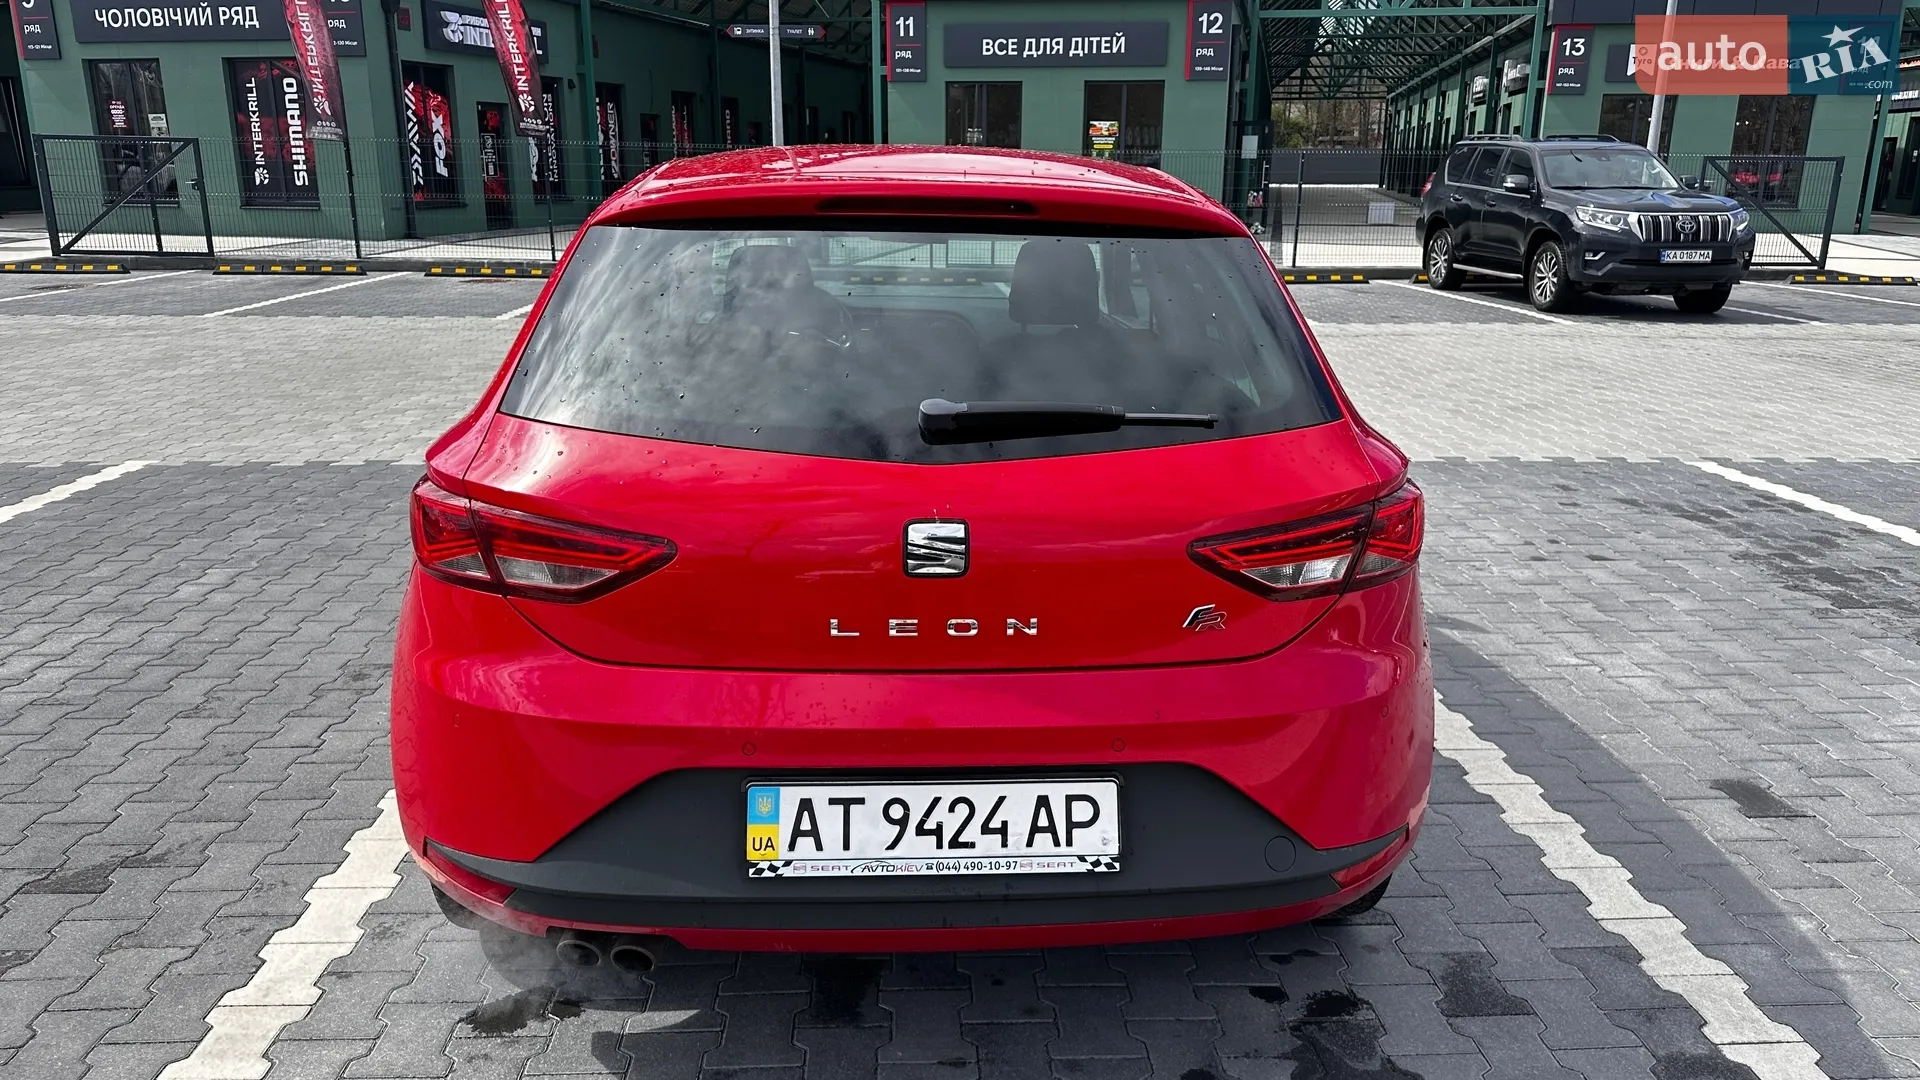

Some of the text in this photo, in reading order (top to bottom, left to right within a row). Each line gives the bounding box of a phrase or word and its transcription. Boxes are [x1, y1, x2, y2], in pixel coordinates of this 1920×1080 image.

[94, 2, 260, 29] ЧОЛОВІЧИЙ РЯД
[327, 19, 347, 29] ряд
[1198, 12, 1224, 34] 12
[23, 24, 42, 35] ряд
[895, 16, 915, 37] 11
[894, 50, 913, 60] ряд
[982, 32, 1126, 58] ВСЕ ДЛЯ ДІТЕЙ
[1195, 48, 1215, 58] ряд
[1562, 38, 1585, 57] 13
[1558, 67, 1575, 75] ряд
[245, 77, 266, 165] INTERKRILL
[283, 77, 309, 186] SHIMANO
[607, 102, 618, 160] OWNER
[430, 108, 449, 178] FOX
[548, 94, 559, 182] INNOVATIONS
[1665, 251, 1711, 260] KA 0187 MA
[830, 618, 1038, 637] LEON
[1182, 603, 1228, 632] FR
[787, 794, 1101, 852] AT 9424 AP
[752, 836, 775, 852] UA
[935, 861, 961, 873] (044)
[963, 861, 1018, 871] 490-10-97
